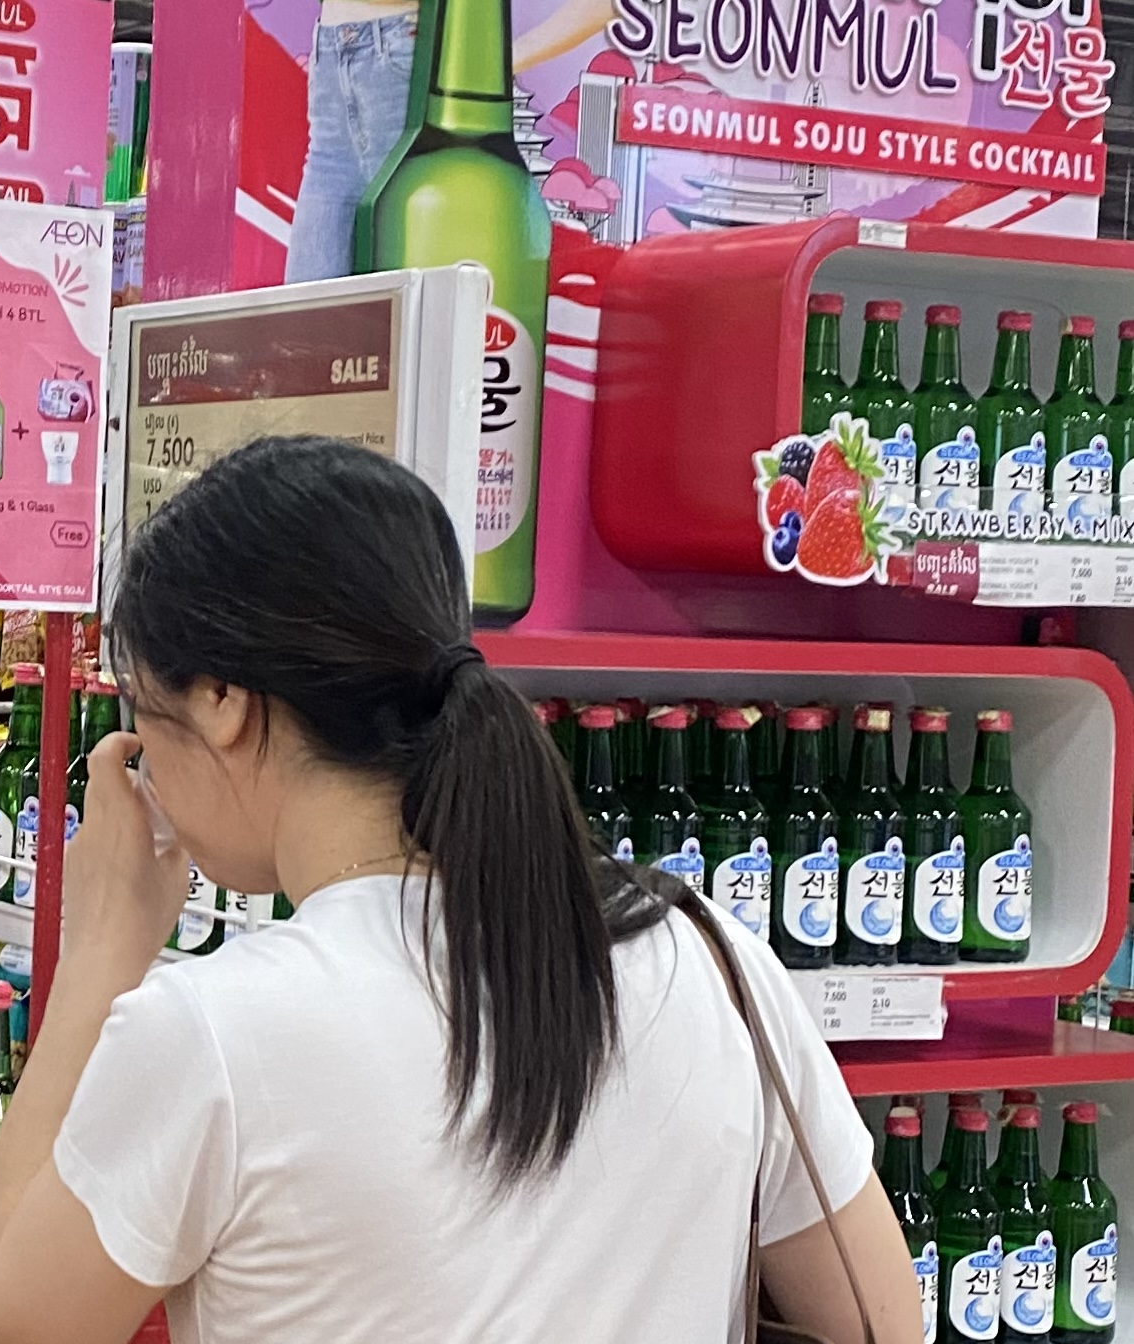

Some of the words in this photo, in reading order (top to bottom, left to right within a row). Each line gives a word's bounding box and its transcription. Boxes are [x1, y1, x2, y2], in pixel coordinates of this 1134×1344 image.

[1001, 22, 1113, 114] 선물
[632, 100, 781, 145] SEONMUL
[794, 119, 866, 155] SOJU
[878, 128, 957, 167] STYLE
[969, 140, 1096, 182] COCKTAIL
[6, 307, 14, 321] 4
[18, 308, 46, 323] BTL
[330, 355, 380, 385] SALE
[143, 478, 162, 494] USD
[27, 500, 55, 513] Glass
[57, 527, 84, 542] Free
[907, 509, 1065, 540] STRAWBERRY
